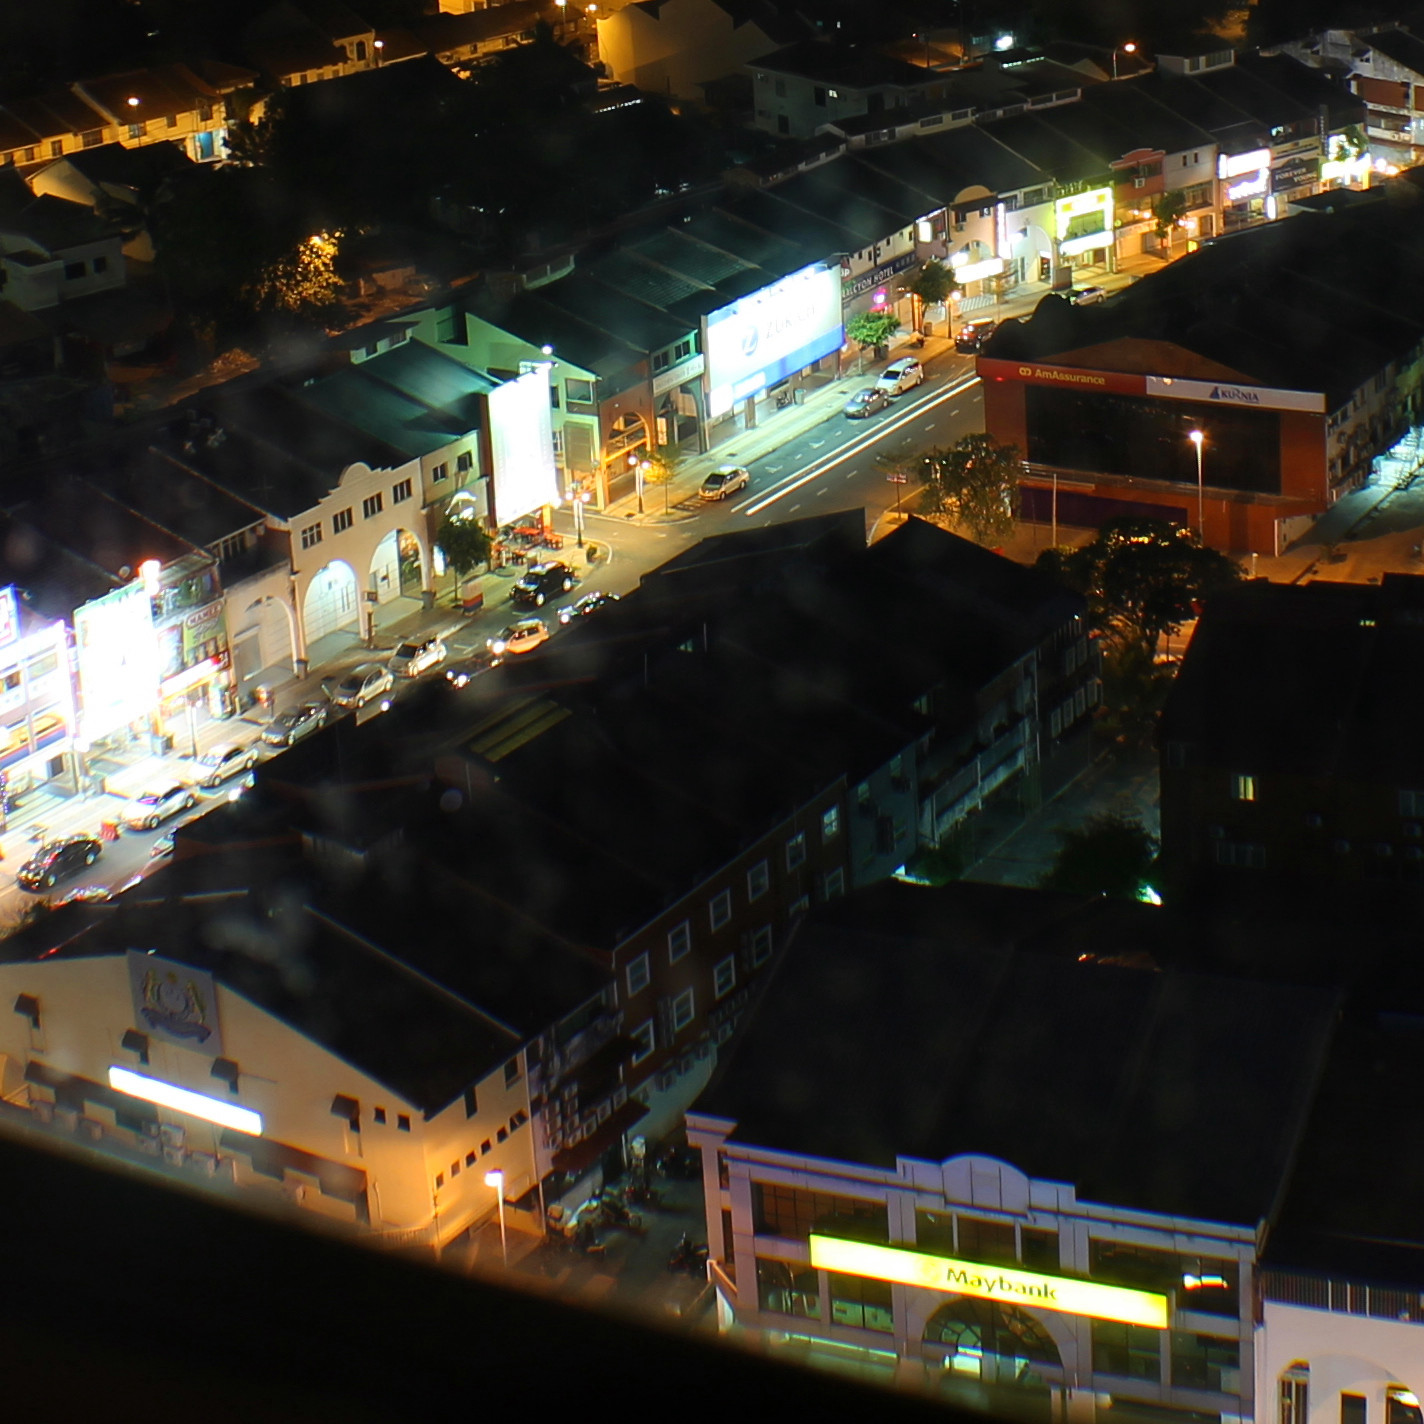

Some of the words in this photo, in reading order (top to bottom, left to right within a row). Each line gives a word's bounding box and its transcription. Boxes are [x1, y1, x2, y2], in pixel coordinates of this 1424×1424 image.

[1034, 368, 1106, 385] AmAssurance
[1220, 387, 1260, 402] KURNIA
[946, 1267, 1057, 1300] Maybank
